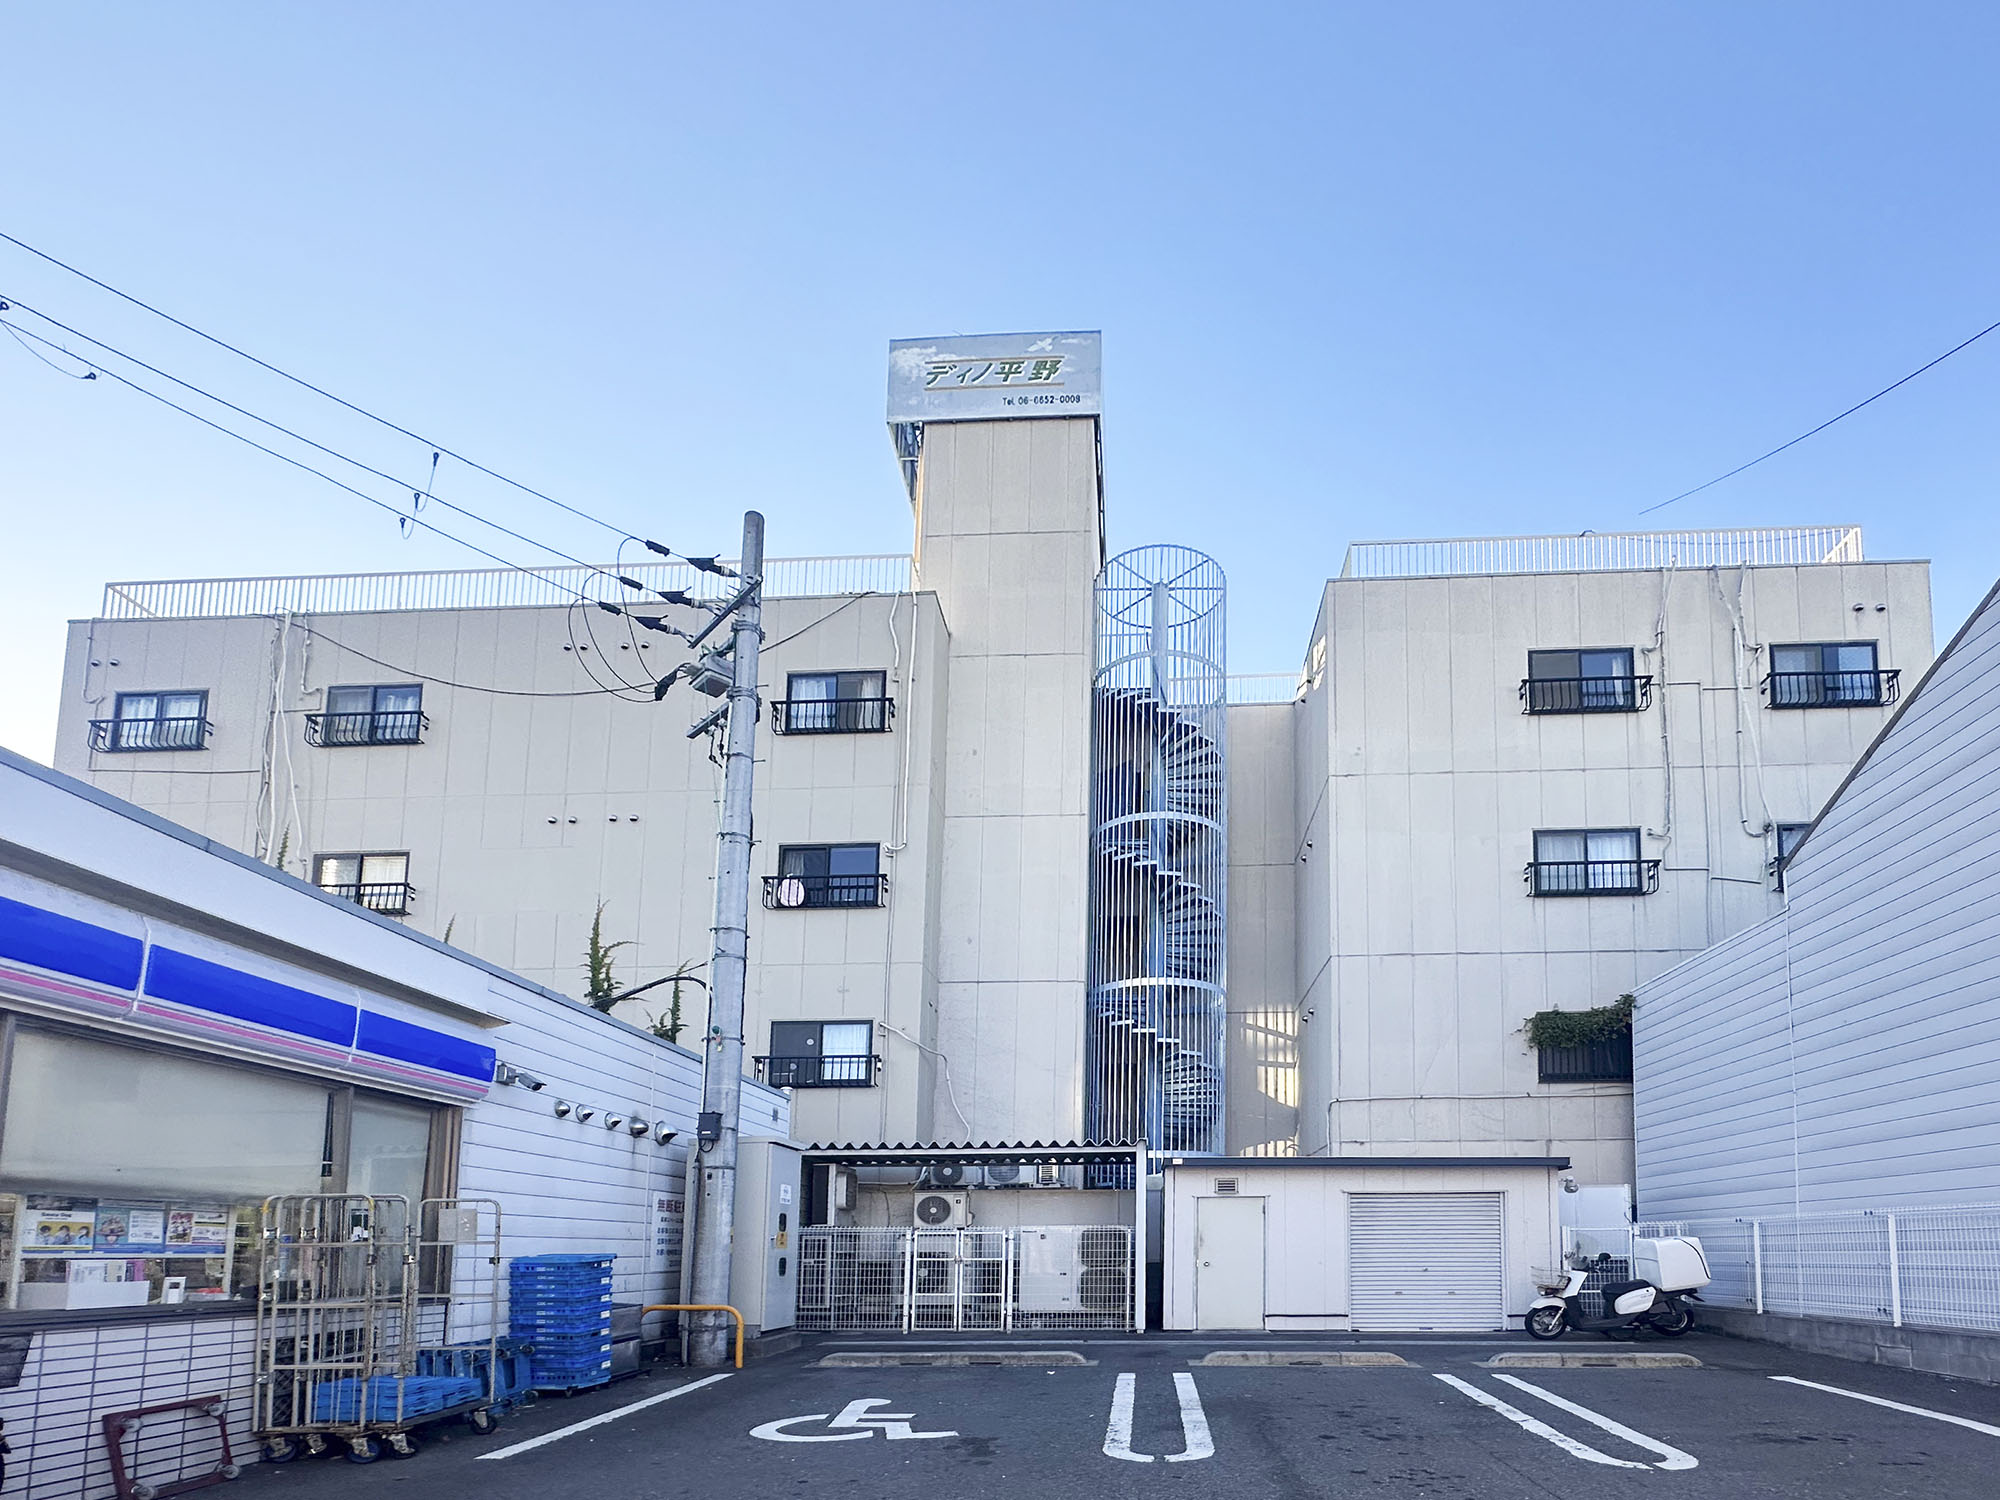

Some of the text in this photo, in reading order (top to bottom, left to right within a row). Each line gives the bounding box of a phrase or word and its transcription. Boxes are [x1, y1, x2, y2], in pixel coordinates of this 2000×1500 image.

[926, 359, 1063, 387] ディノ平野
